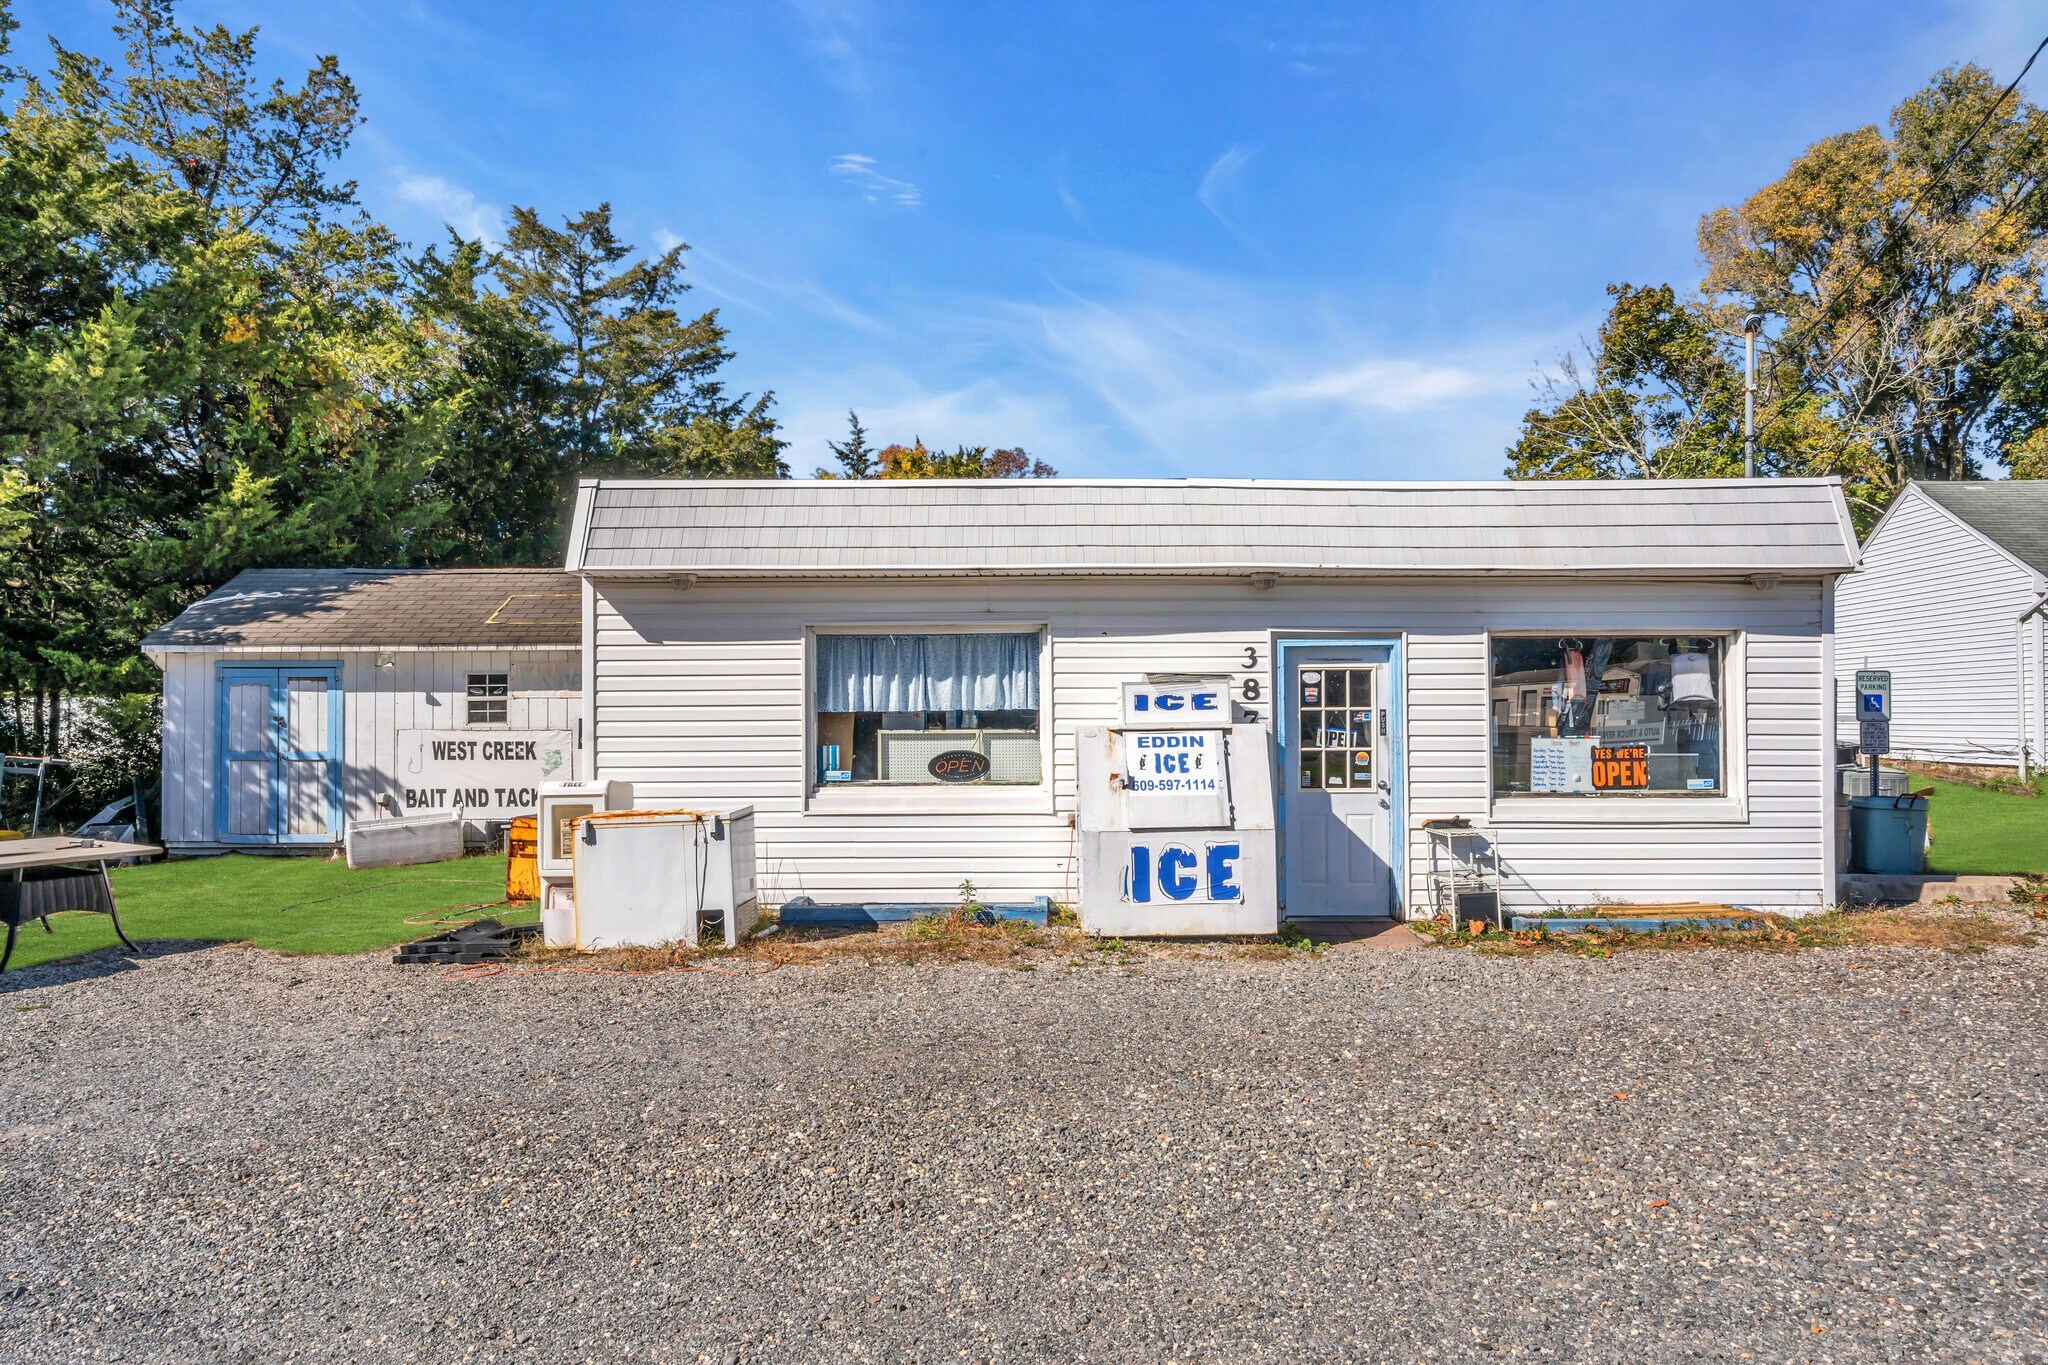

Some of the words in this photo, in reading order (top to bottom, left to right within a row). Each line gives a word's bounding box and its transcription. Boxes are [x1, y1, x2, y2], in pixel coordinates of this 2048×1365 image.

[1134, 693, 1218, 711] ICE
[432, 741, 477, 760] WEST
[482, 741, 537, 760] CREEK
[1137, 736, 1204, 748] EDDIN
[1594, 749, 1612, 759] YES
[1614, 748, 1645, 758] WE'RE
[936, 760, 984, 773] OPEN
[1154, 753, 1190, 773] ICE
[1593, 761, 1647, 787] OPEN
[1132, 779, 1215, 791] 609-597-1114
[406, 789, 447, 808] BAIT
[452, 789, 489, 808] AND
[1130, 841, 1241, 903] ICE
